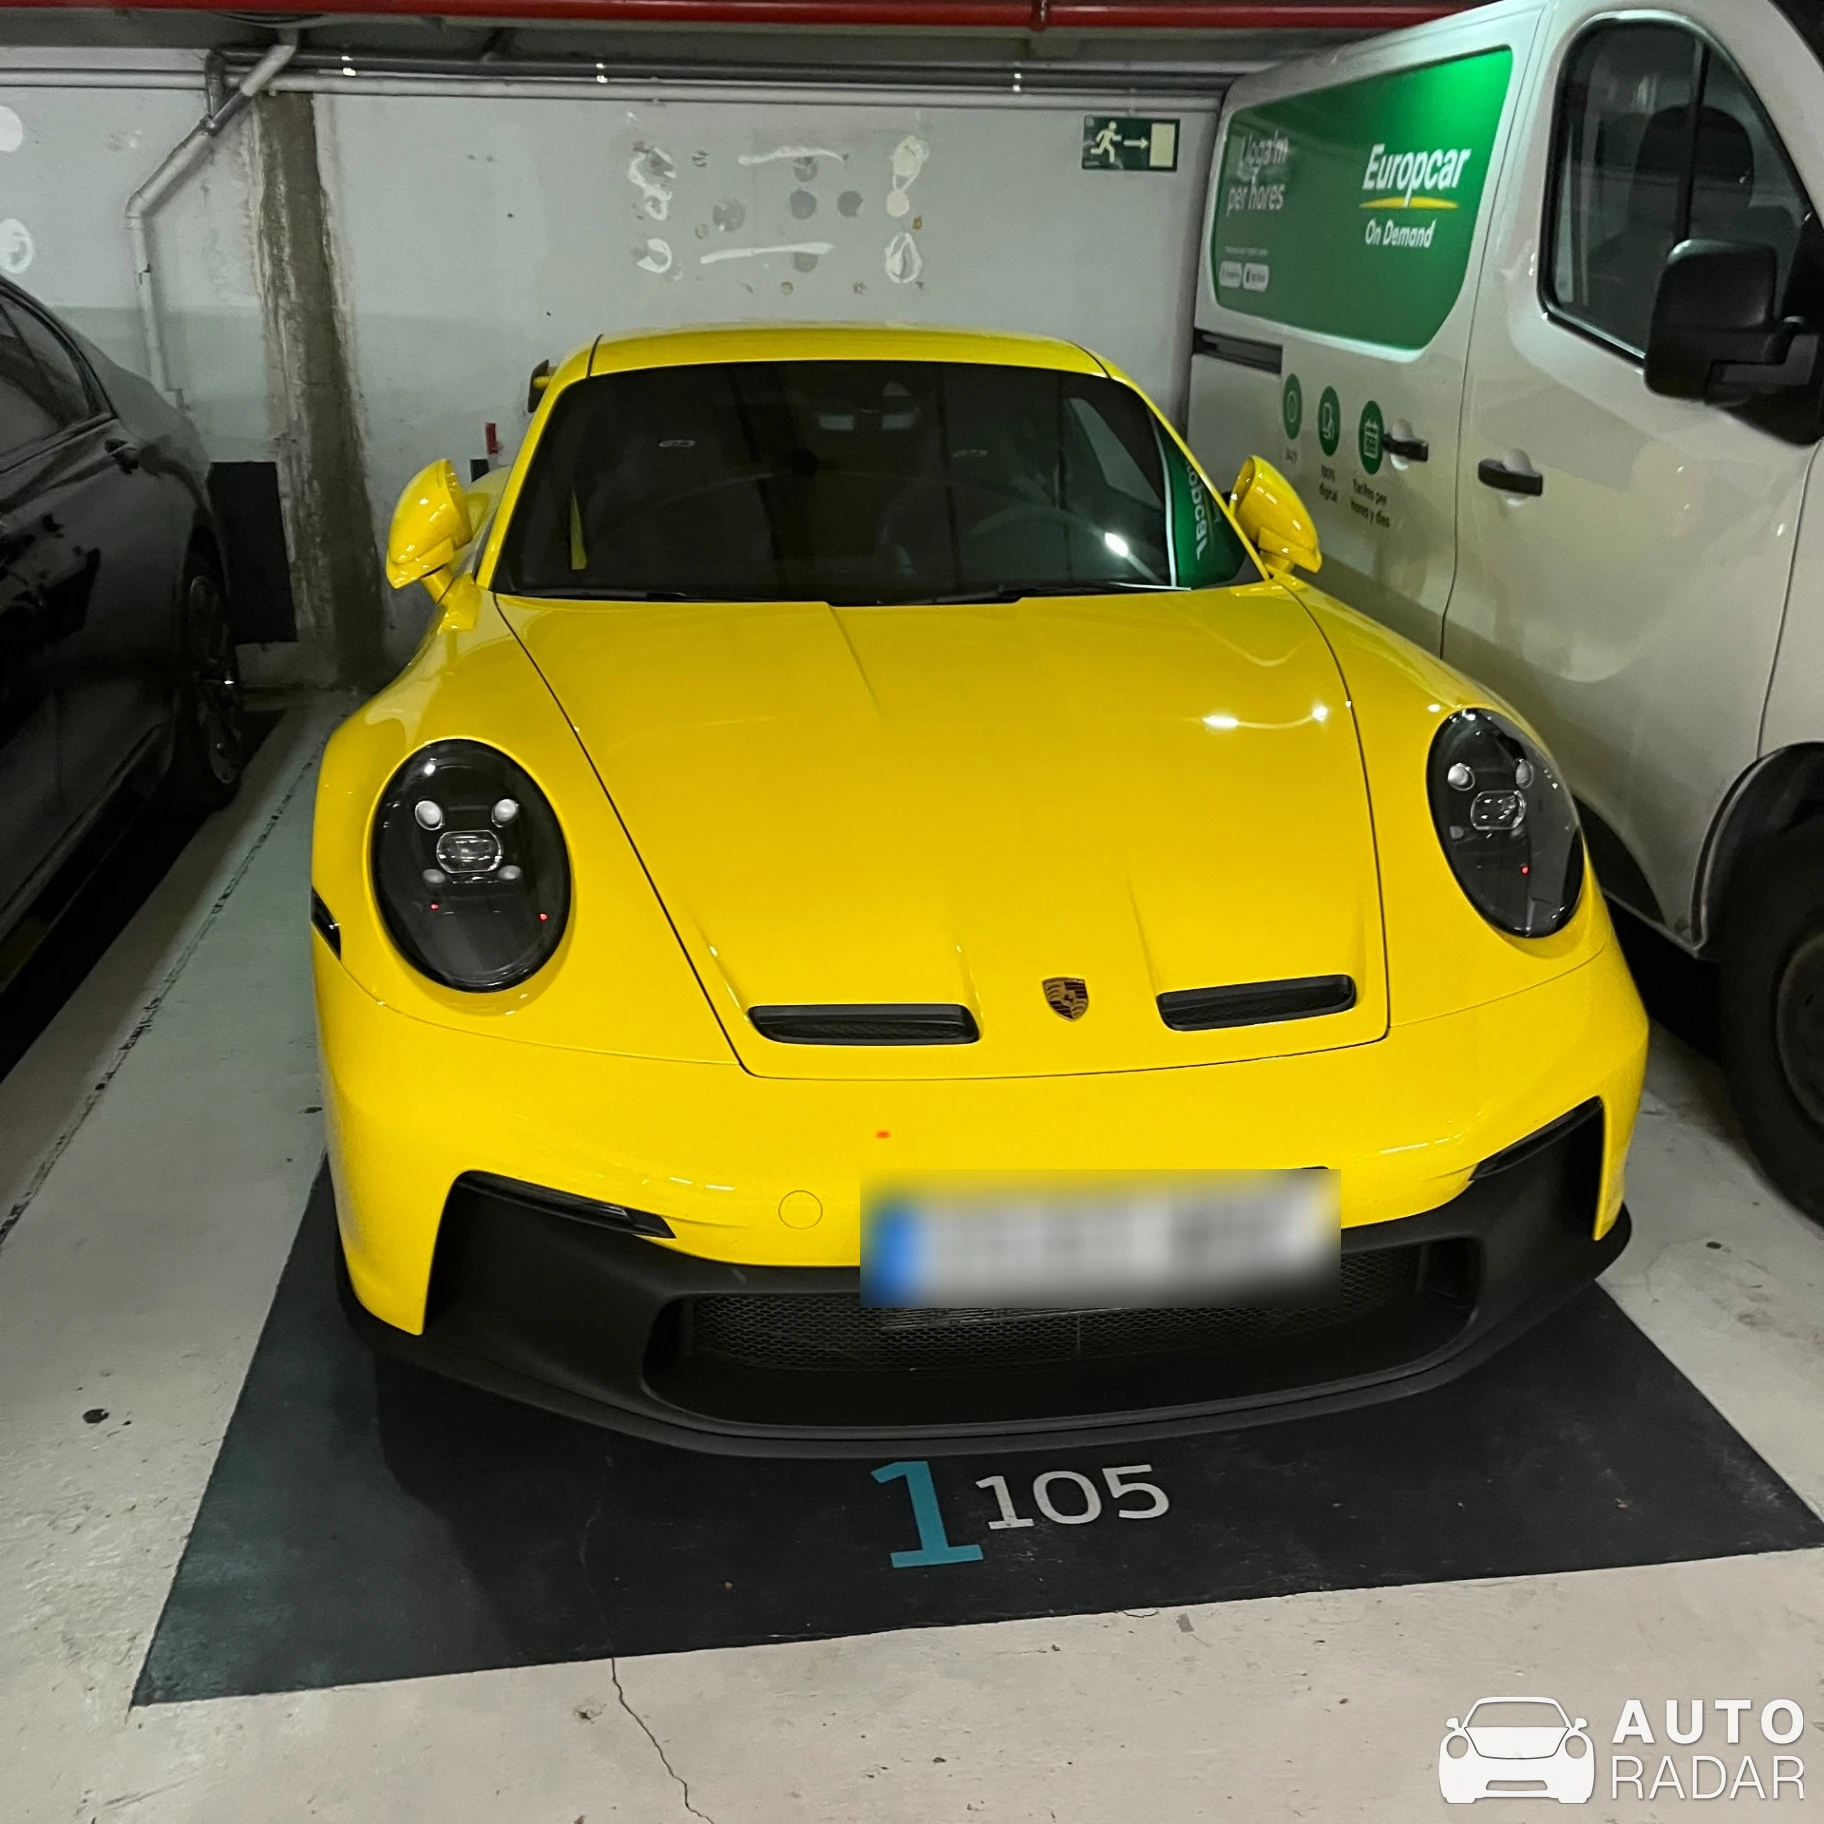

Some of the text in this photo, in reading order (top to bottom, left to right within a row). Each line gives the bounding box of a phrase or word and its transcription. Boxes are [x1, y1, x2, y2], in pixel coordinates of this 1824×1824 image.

[1226, 174, 1286, 217] per hores
[1362, 143, 1472, 208] Europcar
[1365, 218, 1437, 249] On Demand
[870, 1460, 1170, 1568] 1 105
